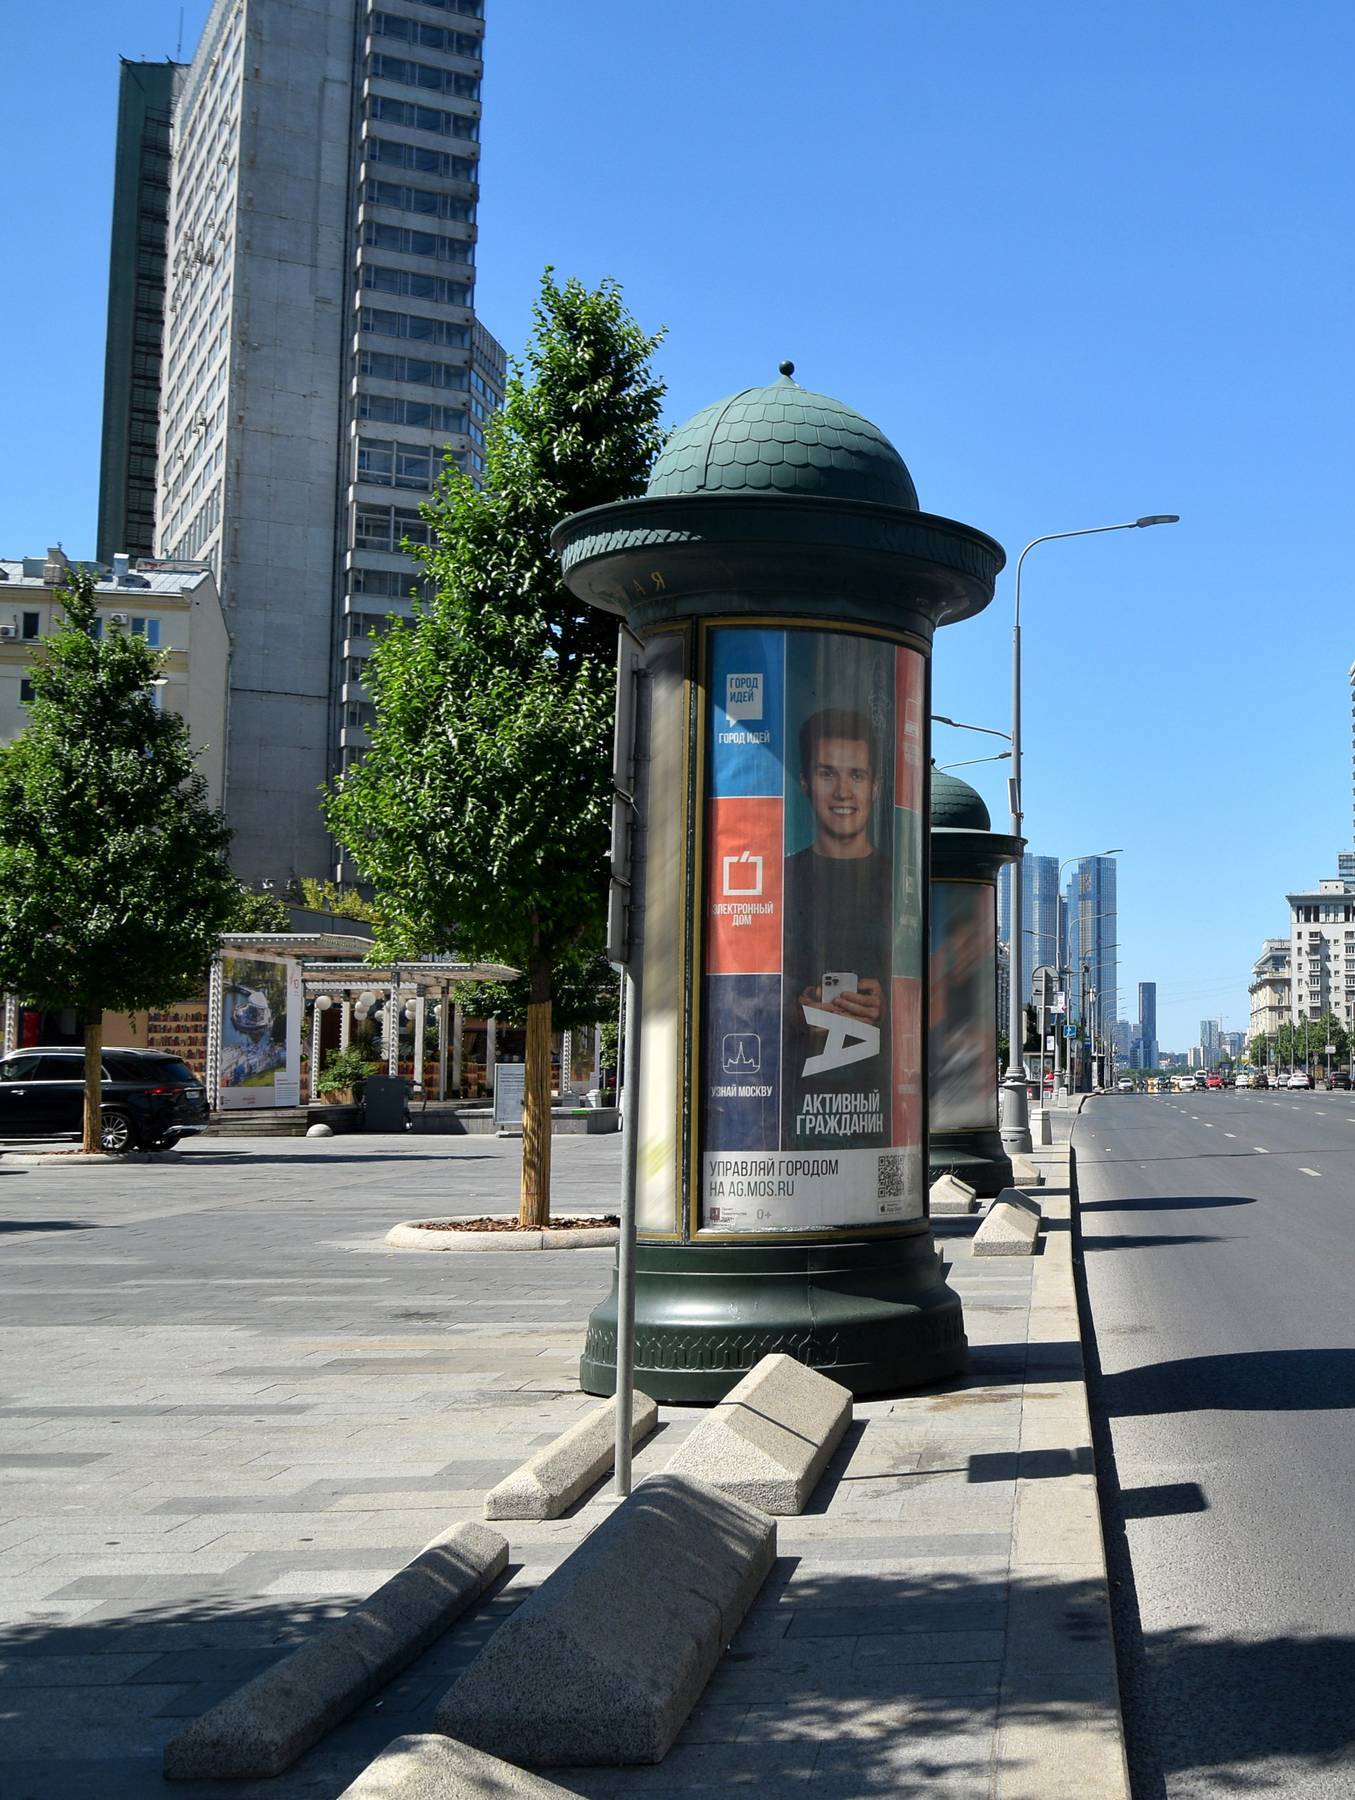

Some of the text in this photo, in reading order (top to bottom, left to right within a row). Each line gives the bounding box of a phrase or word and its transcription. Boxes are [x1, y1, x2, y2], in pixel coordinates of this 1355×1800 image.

[730, 678, 758, 689] ГОРОД
[730, 689, 754, 703] ИДЕЙ
[719, 730, 770, 744] ГОРОД ИДЕЙ
[713, 901, 774, 914] ЭЛЕКТРОННЫЙ
[732, 914, 752, 927] ДОМ
[711, 1084, 773, 1097] УЗНАЙ МОСКВУ
[802, 1089, 880, 1114] АКТИВНЫЙ
[796, 1113, 884, 1136] ГРАЖДАНИН
[710, 1158, 839, 1178] УПРАВЛЯЙ ГОРОДОМ
[709, 1180, 795, 1197] НА AG.MOS.RU
[756, 1208, 772, 1220] 0+
